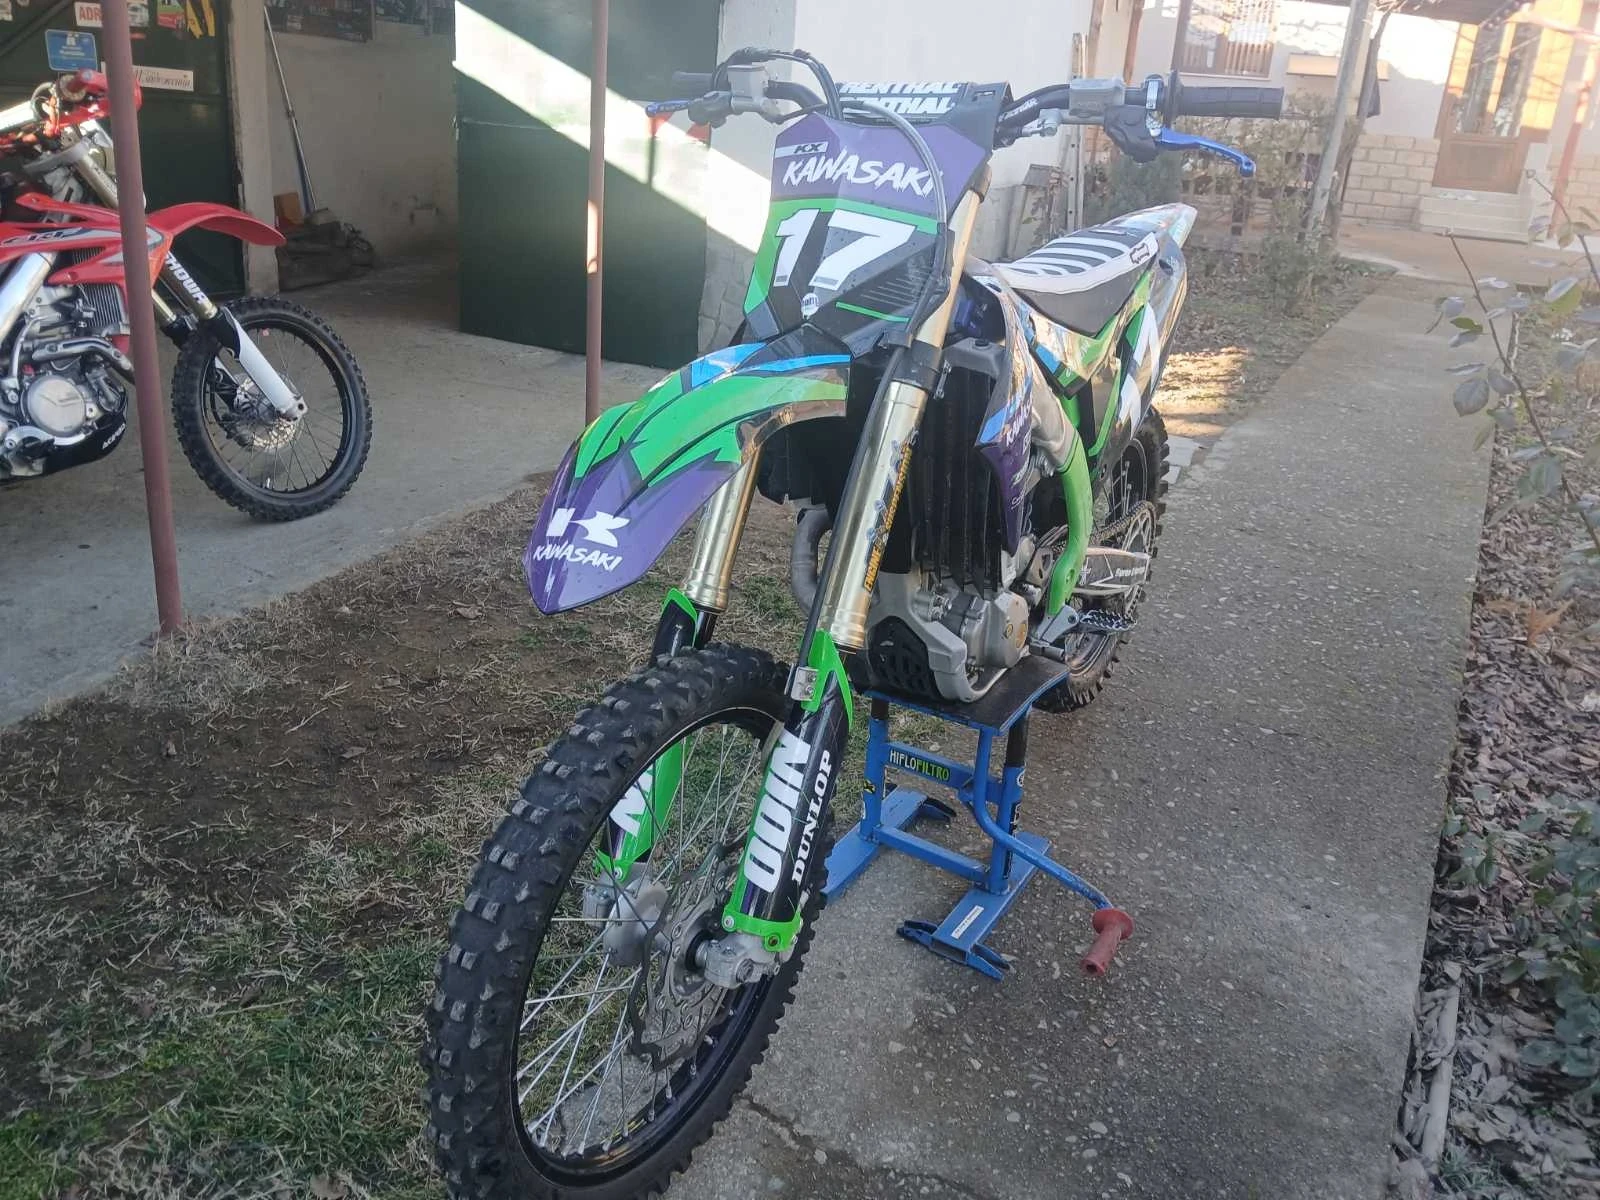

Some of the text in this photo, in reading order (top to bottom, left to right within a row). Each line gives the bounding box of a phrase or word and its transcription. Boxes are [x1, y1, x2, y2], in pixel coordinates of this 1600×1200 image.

[782, 148, 944, 198] KAWASAKI
[773, 208, 917, 291] 17
[533, 540, 623, 573] KAWASAKI
[889, 749, 950, 782] HIFLOFILTRO
[791, 750, 833, 885] DUNLOP
